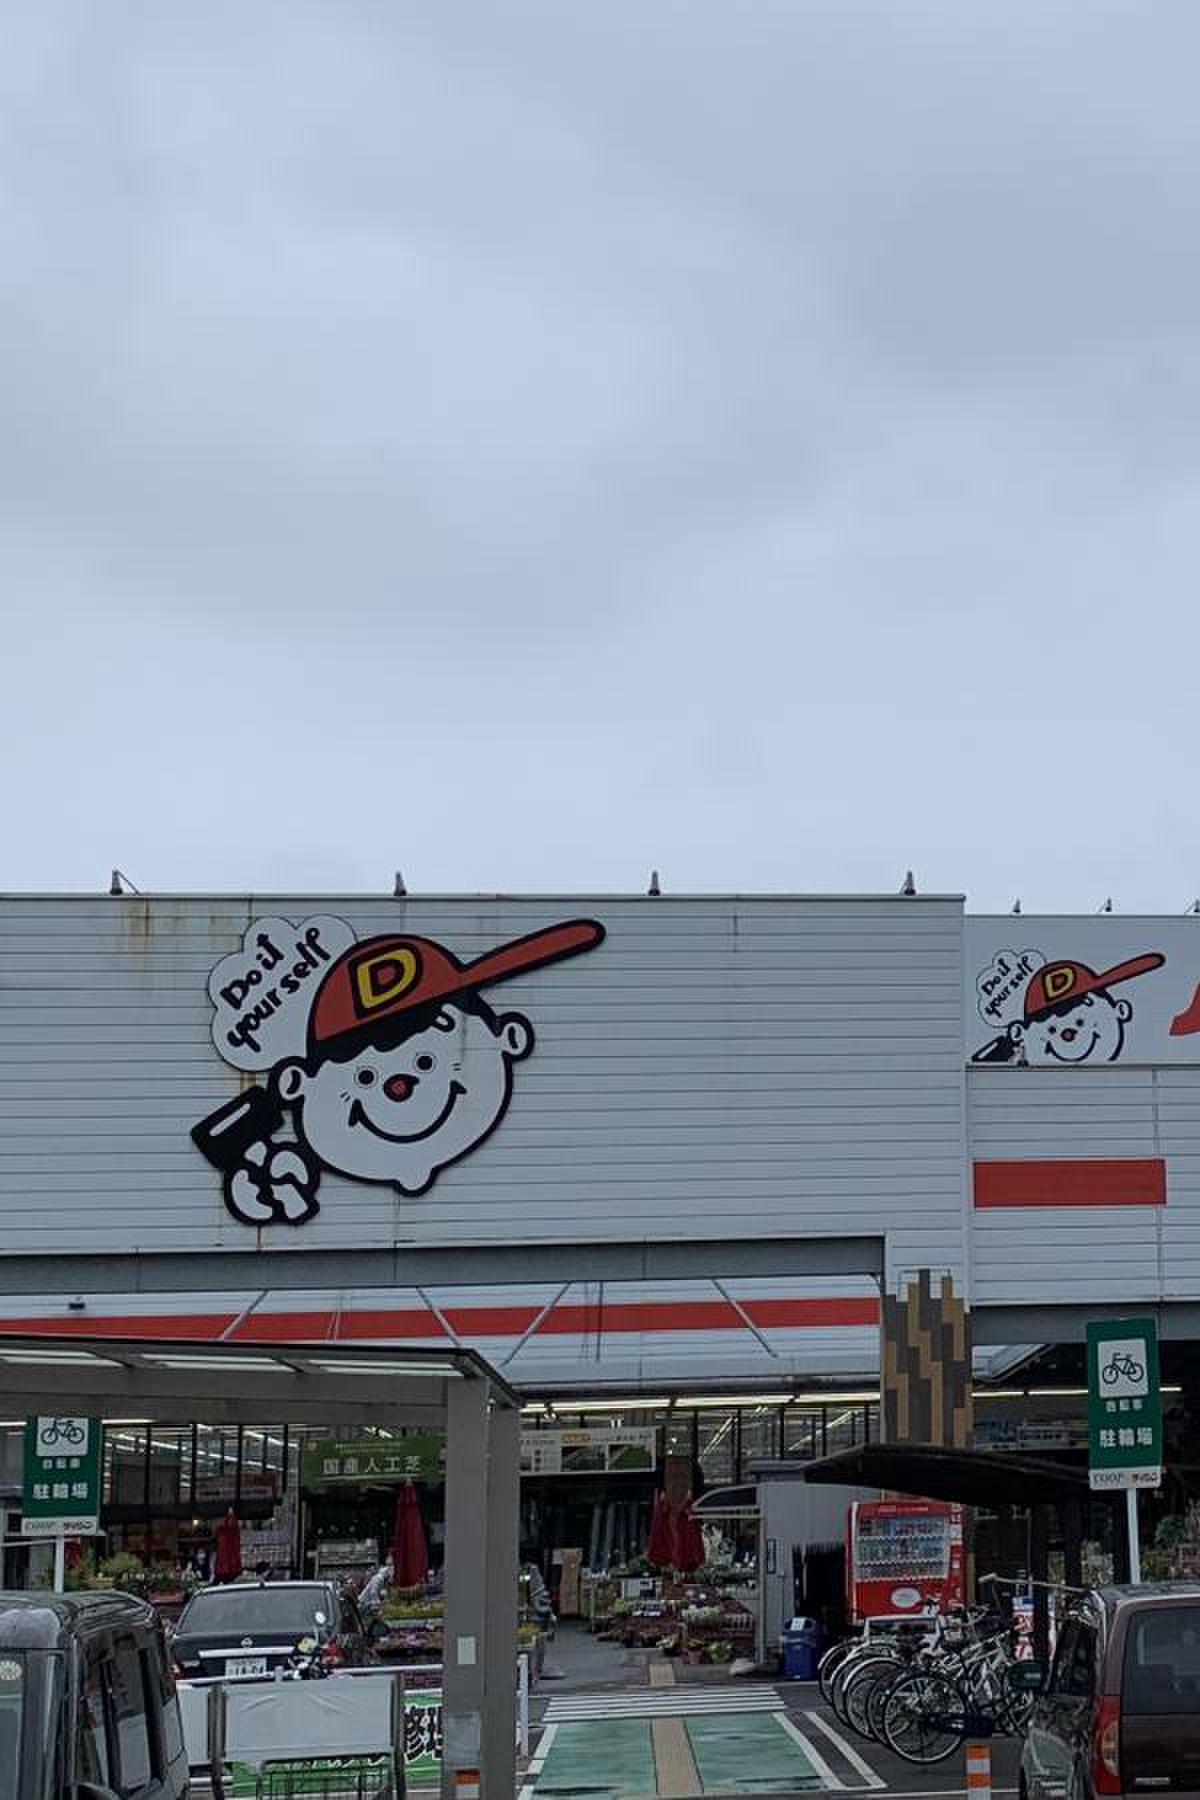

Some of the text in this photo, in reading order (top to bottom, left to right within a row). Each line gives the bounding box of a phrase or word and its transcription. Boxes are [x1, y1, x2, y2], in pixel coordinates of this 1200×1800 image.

[220, 969, 262, 1009] Do
[353, 946, 420, 1012] D
[1044, 966, 1074, 999] D
